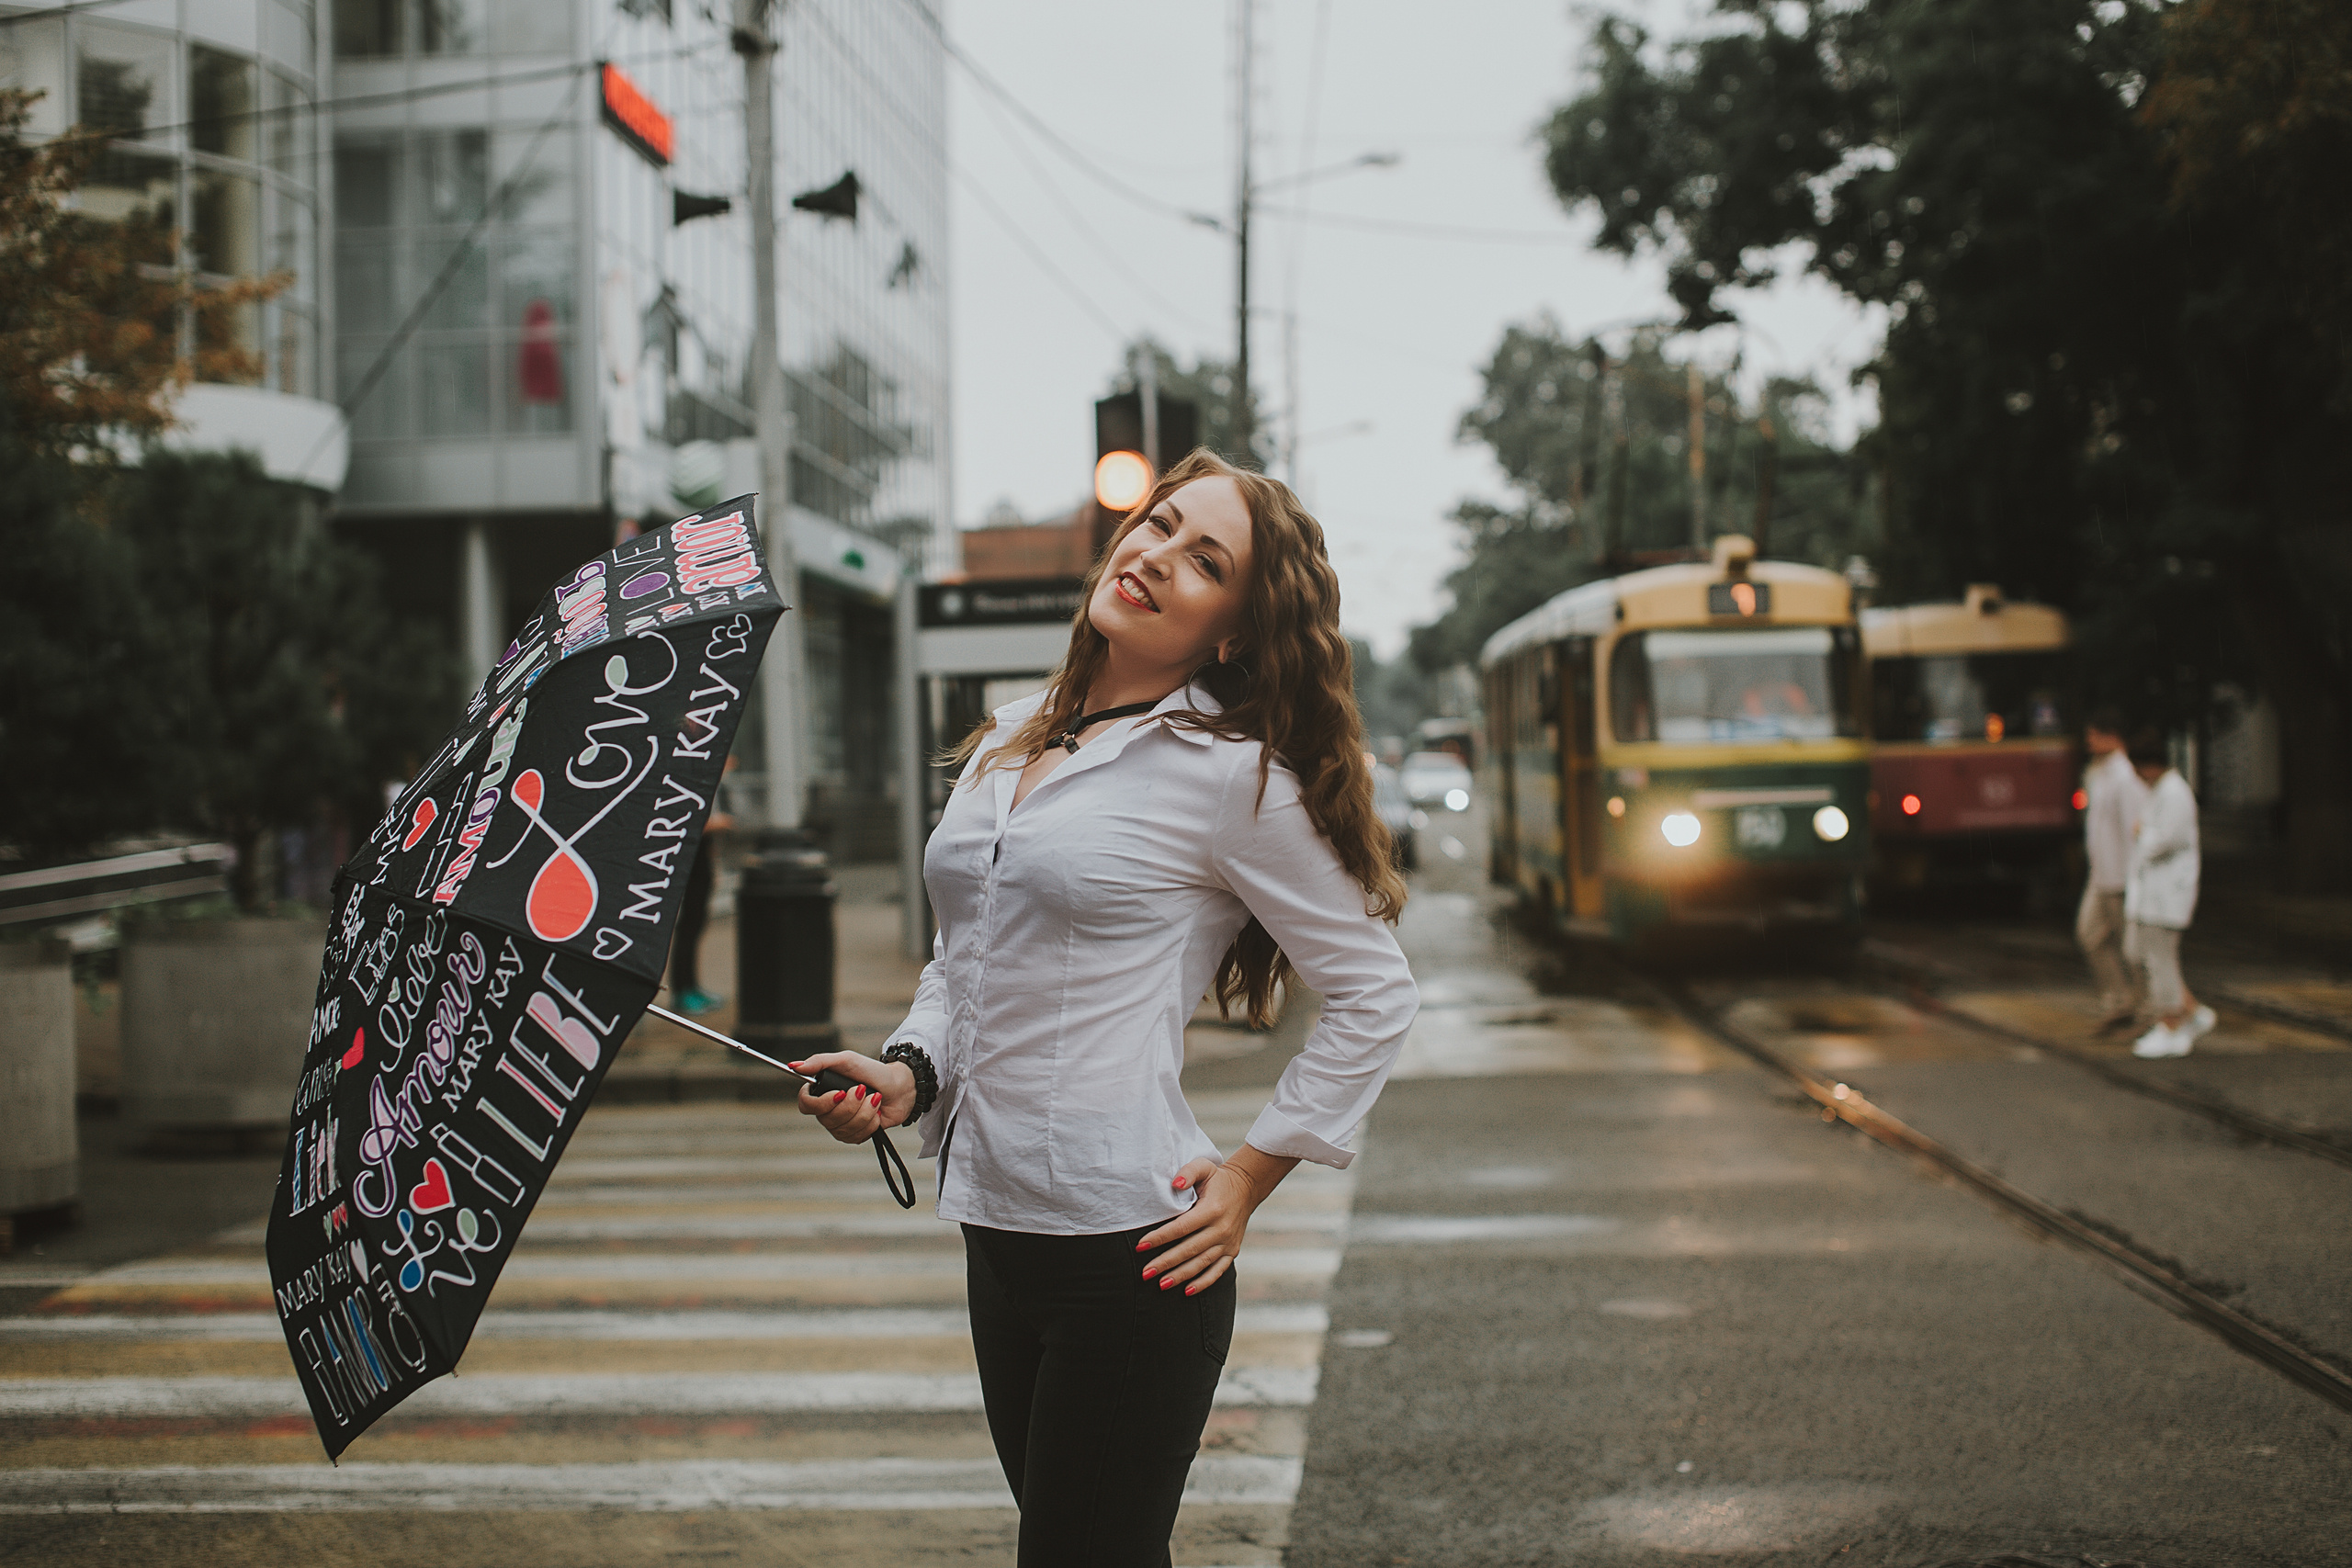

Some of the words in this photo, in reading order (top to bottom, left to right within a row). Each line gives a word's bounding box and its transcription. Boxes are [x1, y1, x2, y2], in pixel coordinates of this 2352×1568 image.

[611, 536, 675, 616] LOVE
[370, 812, 407, 886] MK
[432, 697, 529, 907] AMOUR
[618, 774, 707, 924] MARY
[672, 662, 741, 760] KAY
[353, 931, 487, 1219] Amour
[441, 1009, 494, 1113] MARY
[484, 935, 526, 1009] KAY
[475, 952, 621, 1162] LIEBE
[276, 1253, 325, 1320] MARY
[329, 1240, 353, 1286] KAY
[319, 1286, 403, 1416] AMOR
